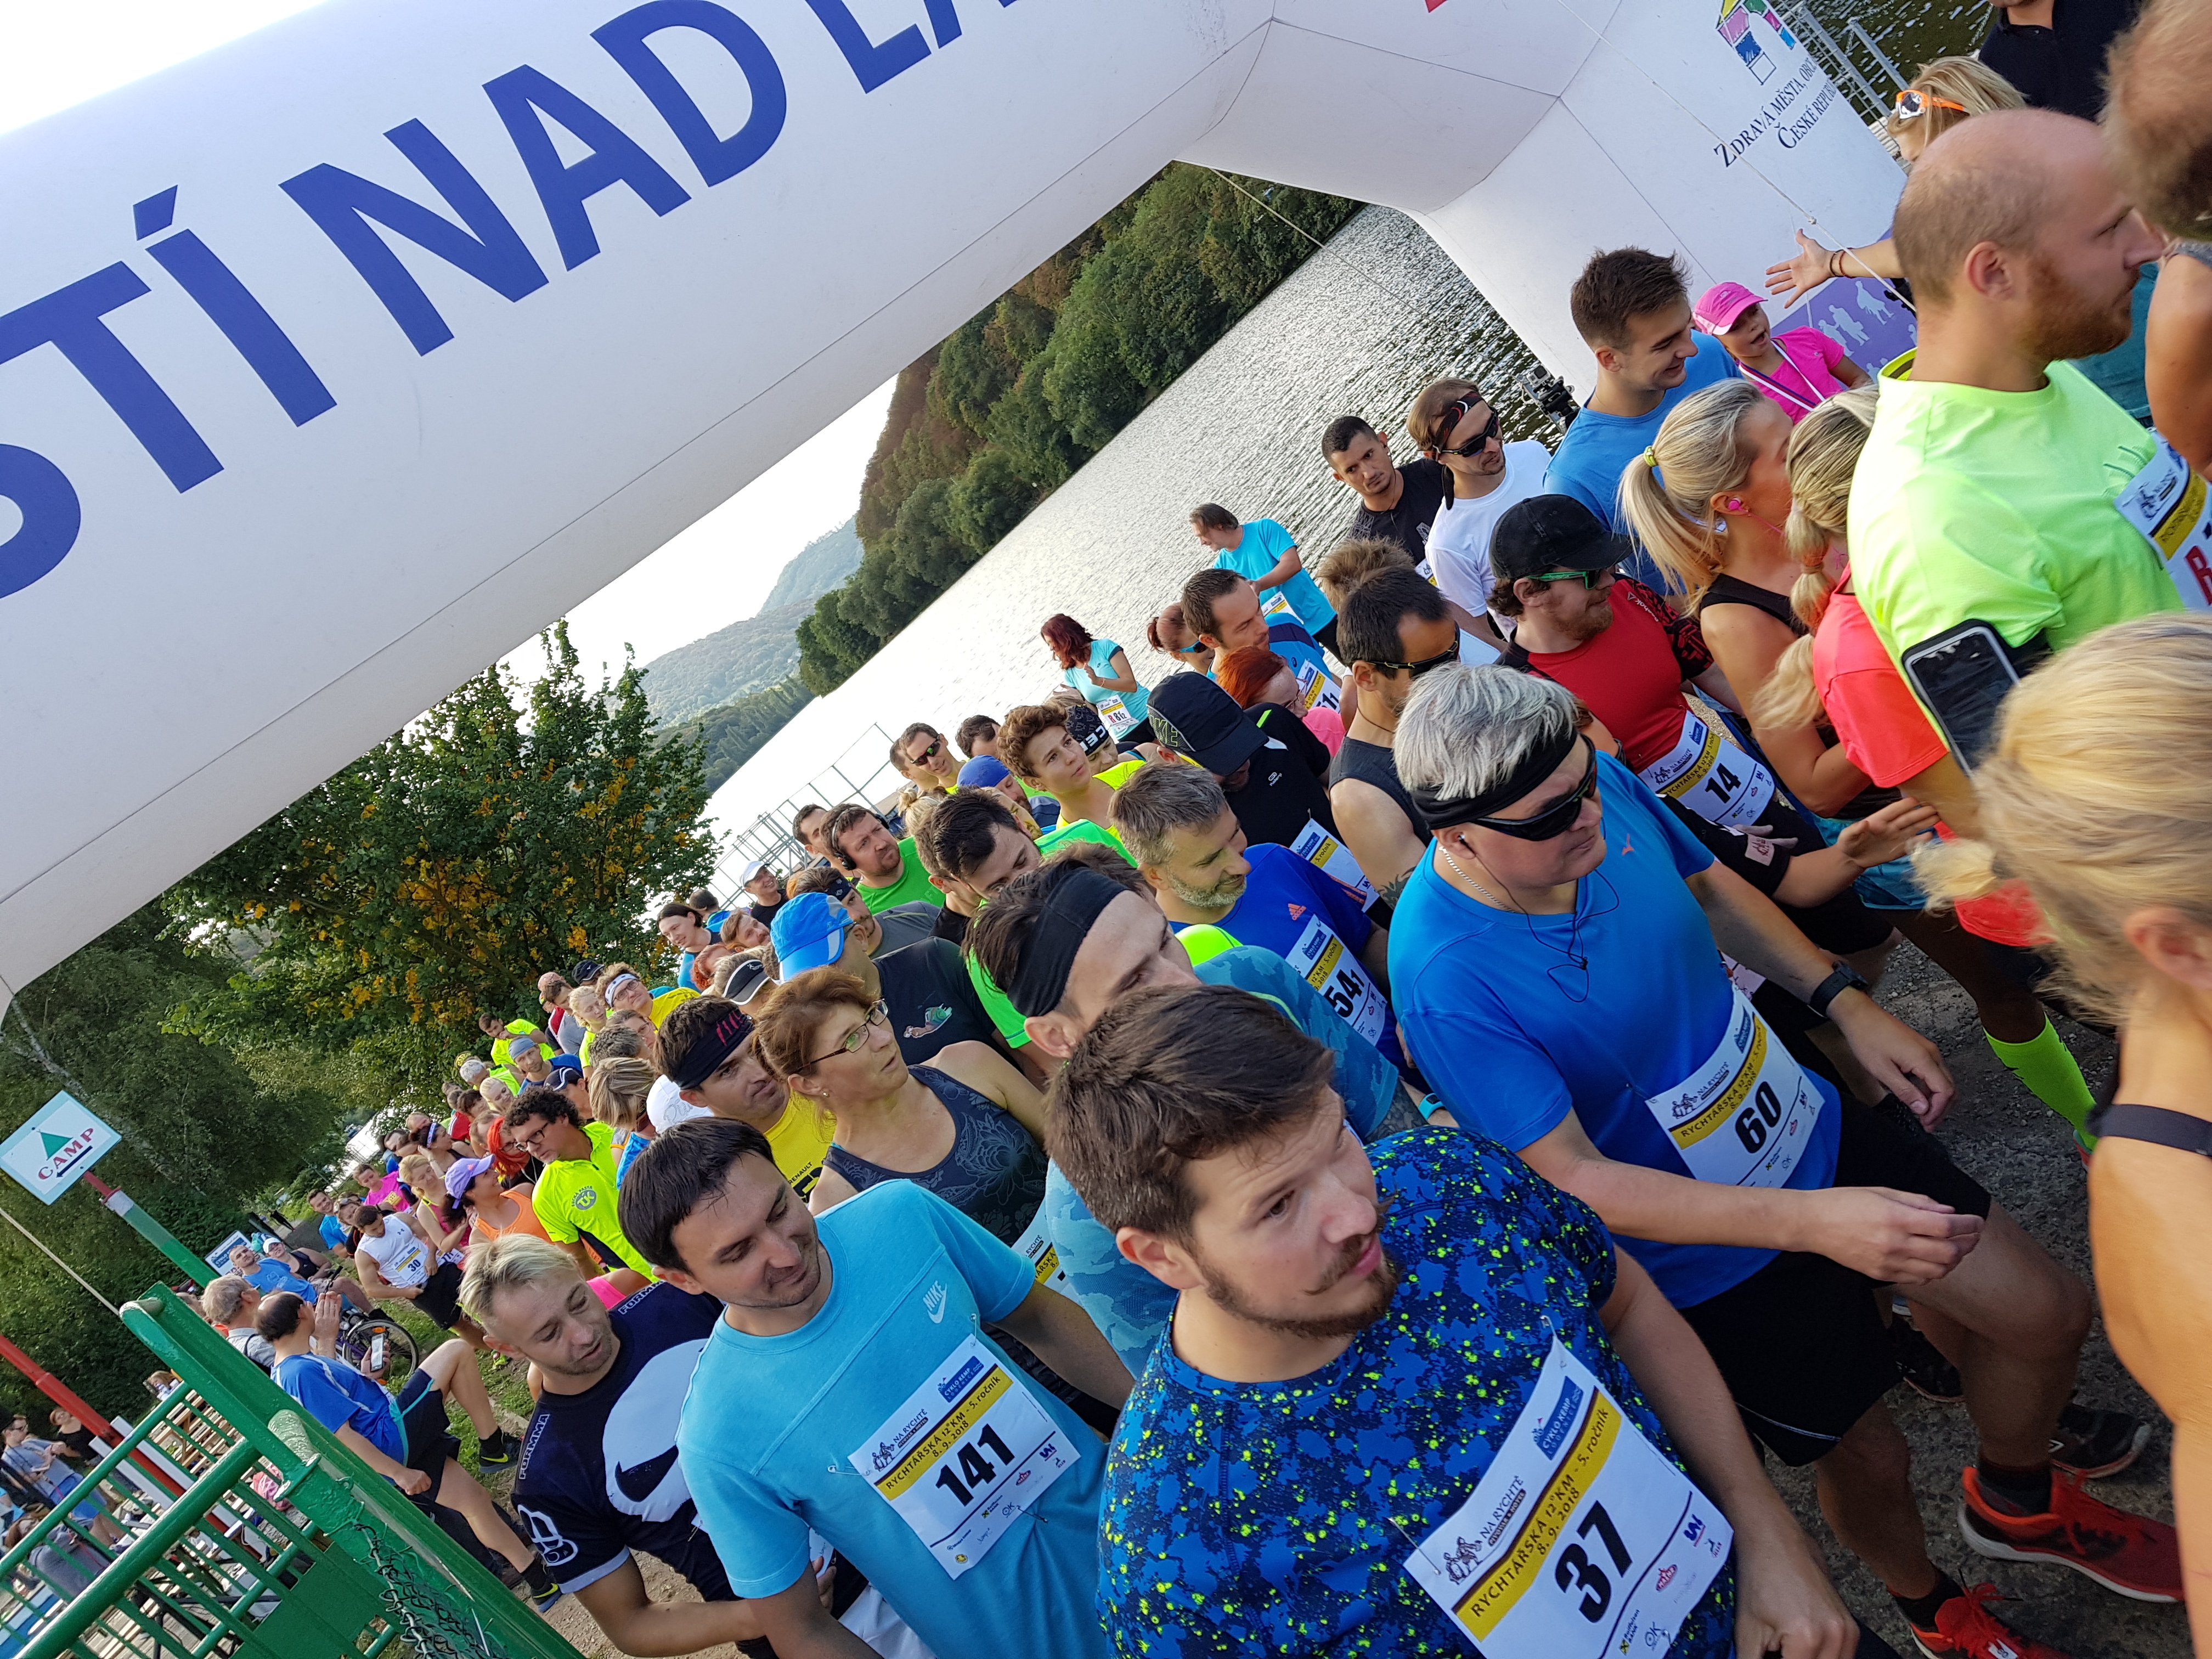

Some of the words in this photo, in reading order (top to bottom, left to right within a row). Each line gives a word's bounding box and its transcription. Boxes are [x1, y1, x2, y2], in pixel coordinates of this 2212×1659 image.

[1713, 105, 1776, 168] ZDRAVÁ
[1773, 104, 1819, 149] ČESKÉ
[279, 0, 786, 357] NAD
[1705, 763, 1741, 804] 14
[1319, 843, 1331, 857] ročník
[1318, 970, 1328, 985] 2018
[1735, 1081, 1781, 1154] 60
[38, 1128, 94, 1180] CAMP
[408, 1259, 421, 1272] 30
[923, 1280, 945, 1311] NIKE
[944, 1380, 960, 1396] CYKLO
[958, 1368, 971, 1381] KEMP
[518, 1413, 550, 1480] FORMMA
[885, 1435, 942, 1489] RYCHTÁŘSKÁ
[969, 1401, 978, 1409] 5.
[977, 1375, 1001, 1402] ročník
[893, 1432, 904, 1443] NA
[933, 1449, 942, 1458] 8.
[943, 1441, 951, 1450] 9.
[951, 1420, 969, 1440] 2018
[1542, 1420, 1561, 1449] CYKLO
[1557, 1397, 1571, 1422] KEMP
[935, 1423, 1015, 1507] 141
[1470, 1518, 1547, 1618] RYCHTÁŘSKÁ
[1577, 1454, 1590, 1467] 5.
[1587, 1408, 1609, 1453] ročník
[1480, 1521, 1496, 1539] NA
[1537, 1542, 1550, 1555] 8.
[1548, 1525, 1559, 1541] 9.
[1558, 1487, 1580, 1521] 2018
[1555, 1500, 1633, 1623] 37
